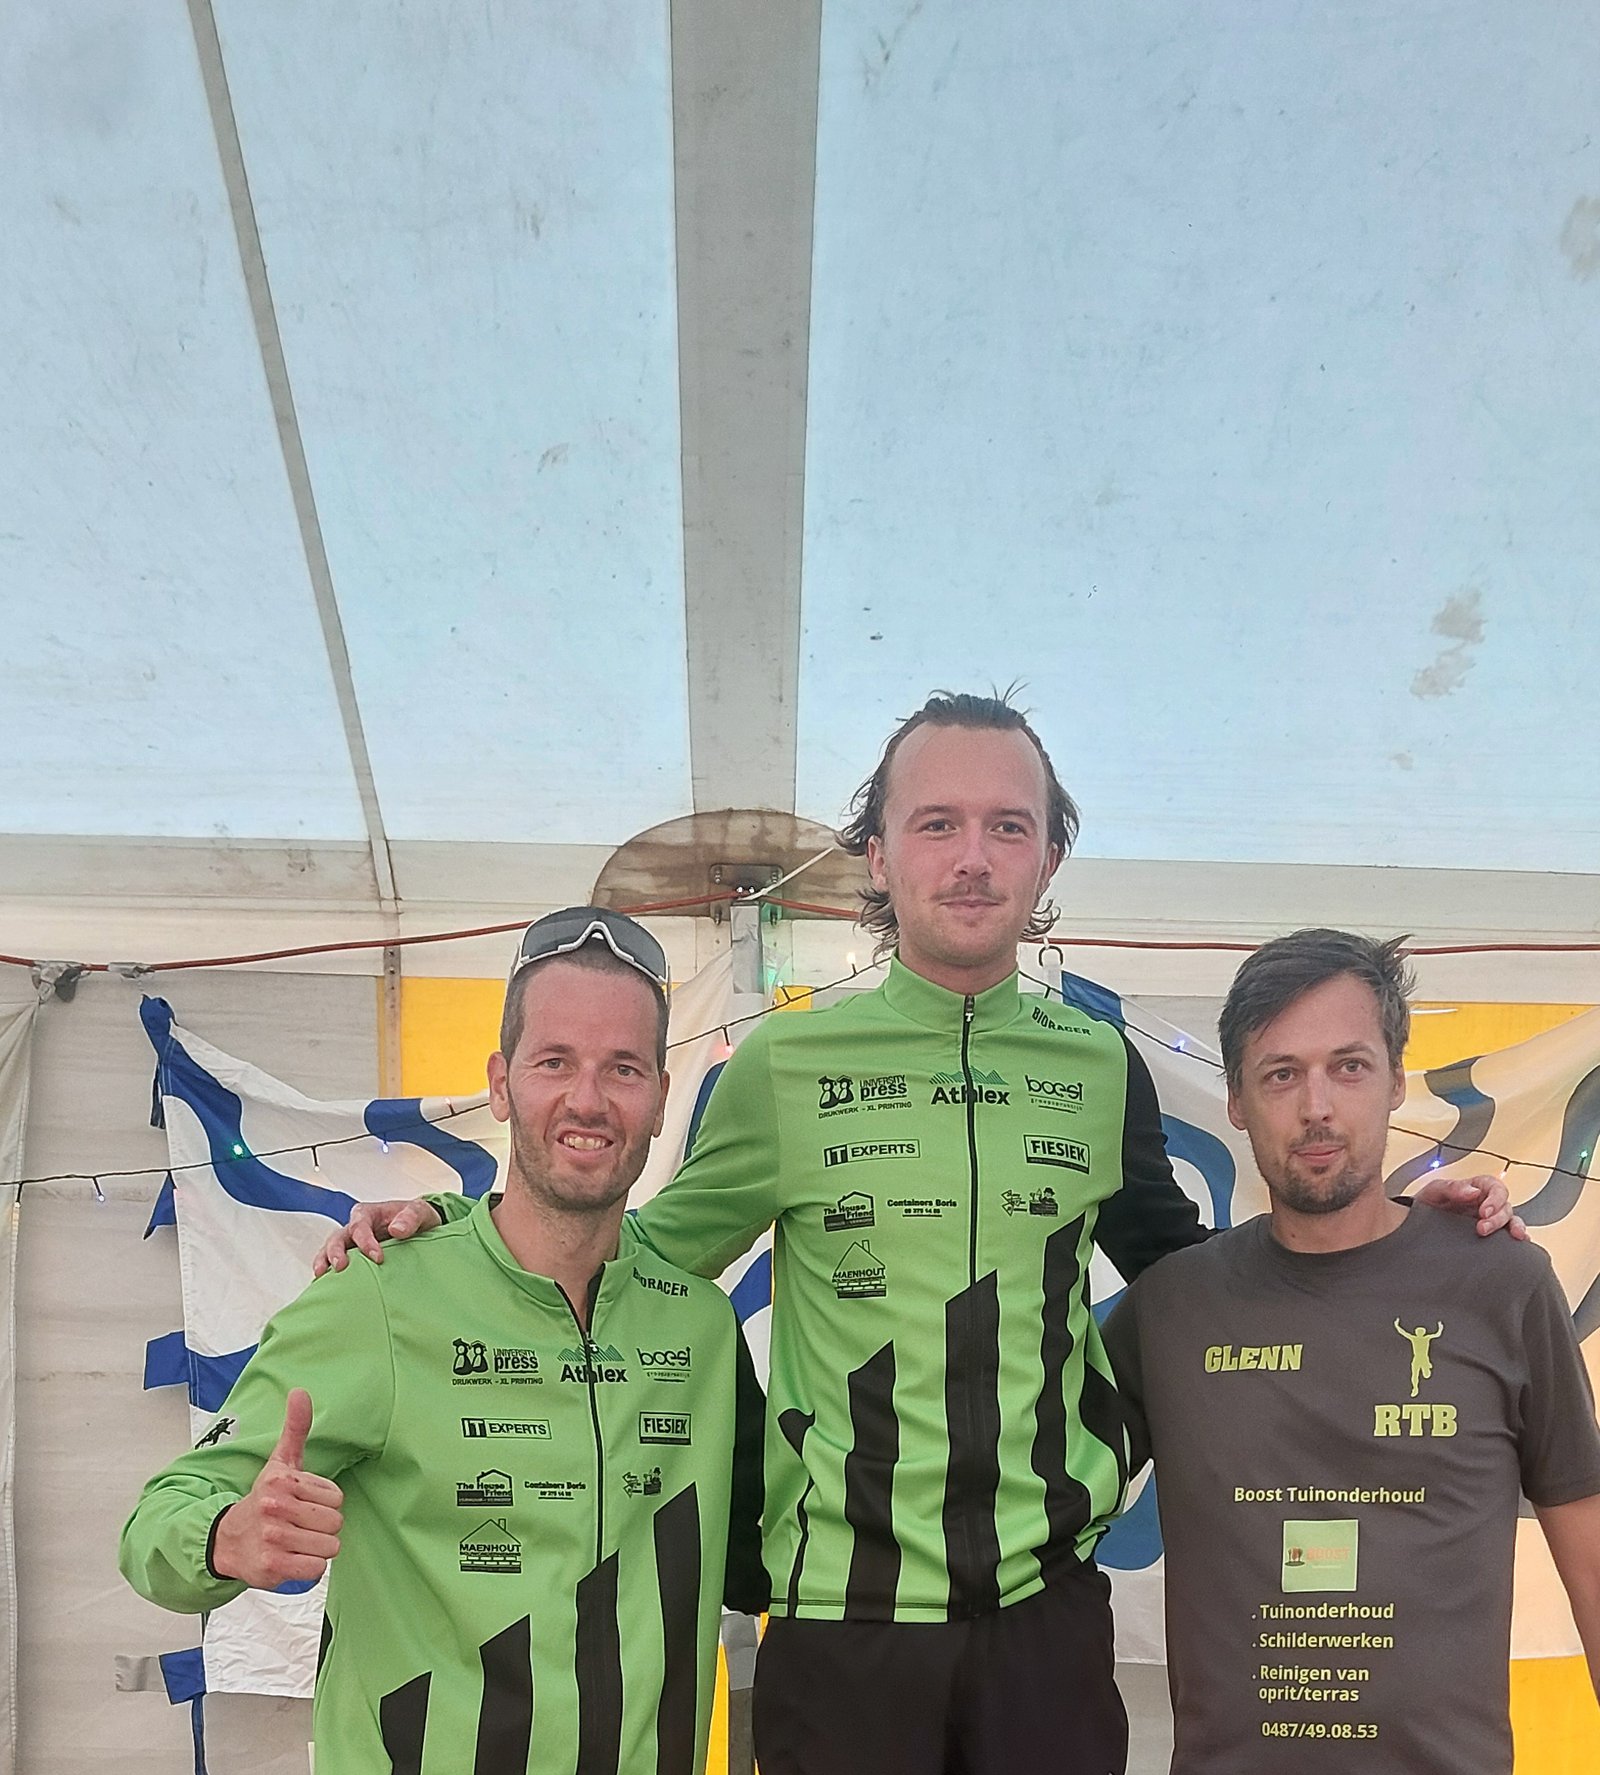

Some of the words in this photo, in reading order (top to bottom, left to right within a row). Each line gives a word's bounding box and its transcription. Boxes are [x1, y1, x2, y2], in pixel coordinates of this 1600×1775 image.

[1032, 1006, 1091, 1036] BIORACER
[860, 1075, 905, 1088] UNIVERSITY
[861, 1082, 907, 1101] press
[931, 1085, 1011, 1105] Athlex
[818, 1106, 859, 1119] DRUKWERK
[867, 1104, 876, 1112] XL
[878, 1101, 912, 1110] PRINTING
[826, 1146, 846, 1166] IT
[851, 1143, 916, 1157] EXPERTS
[1030, 1140, 1086, 1163] FIESIEK
[839, 1204, 866, 1213] House
[887, 1199, 933, 1207] Containers
[935, 1199, 957, 1208] Boris
[846, 1209, 874, 1219] Friend
[833, 1267, 885, 1279] MAENHOUT
[633, 1267, 688, 1297] BORACER
[494, 1356, 538, 1373] press
[1204, 1344, 1303, 1373] GLENN
[560, 1364, 629, 1383] Athlex
[464, 1419, 484, 1436] IT
[488, 1423, 547, 1435] EXPERTS
[643, 1417, 687, 1434] FIESIEK
[1373, 1403, 1457, 1437] RTB
[477, 1482, 505, 1490] House
[485, 1489, 512, 1497] Friend
[524, 1481, 564, 1489] Containers
[1234, 1487, 1283, 1502] Boost
[1287, 1486, 1425, 1503] Tuinonderhoud
[460, 1544, 521, 1552] MAENHOUT
[1260, 1603, 1394, 1619] Tuinonderhoud
[1259, 1632, 1394, 1648] Schilderwerken
[1260, 1665, 1331, 1684] Reinigen
[1336, 1668, 1369, 1681] van
[1259, 1685, 1359, 1704] oprit/terras
[1262, 1722, 1378, 1738] 0487/49.08.53
